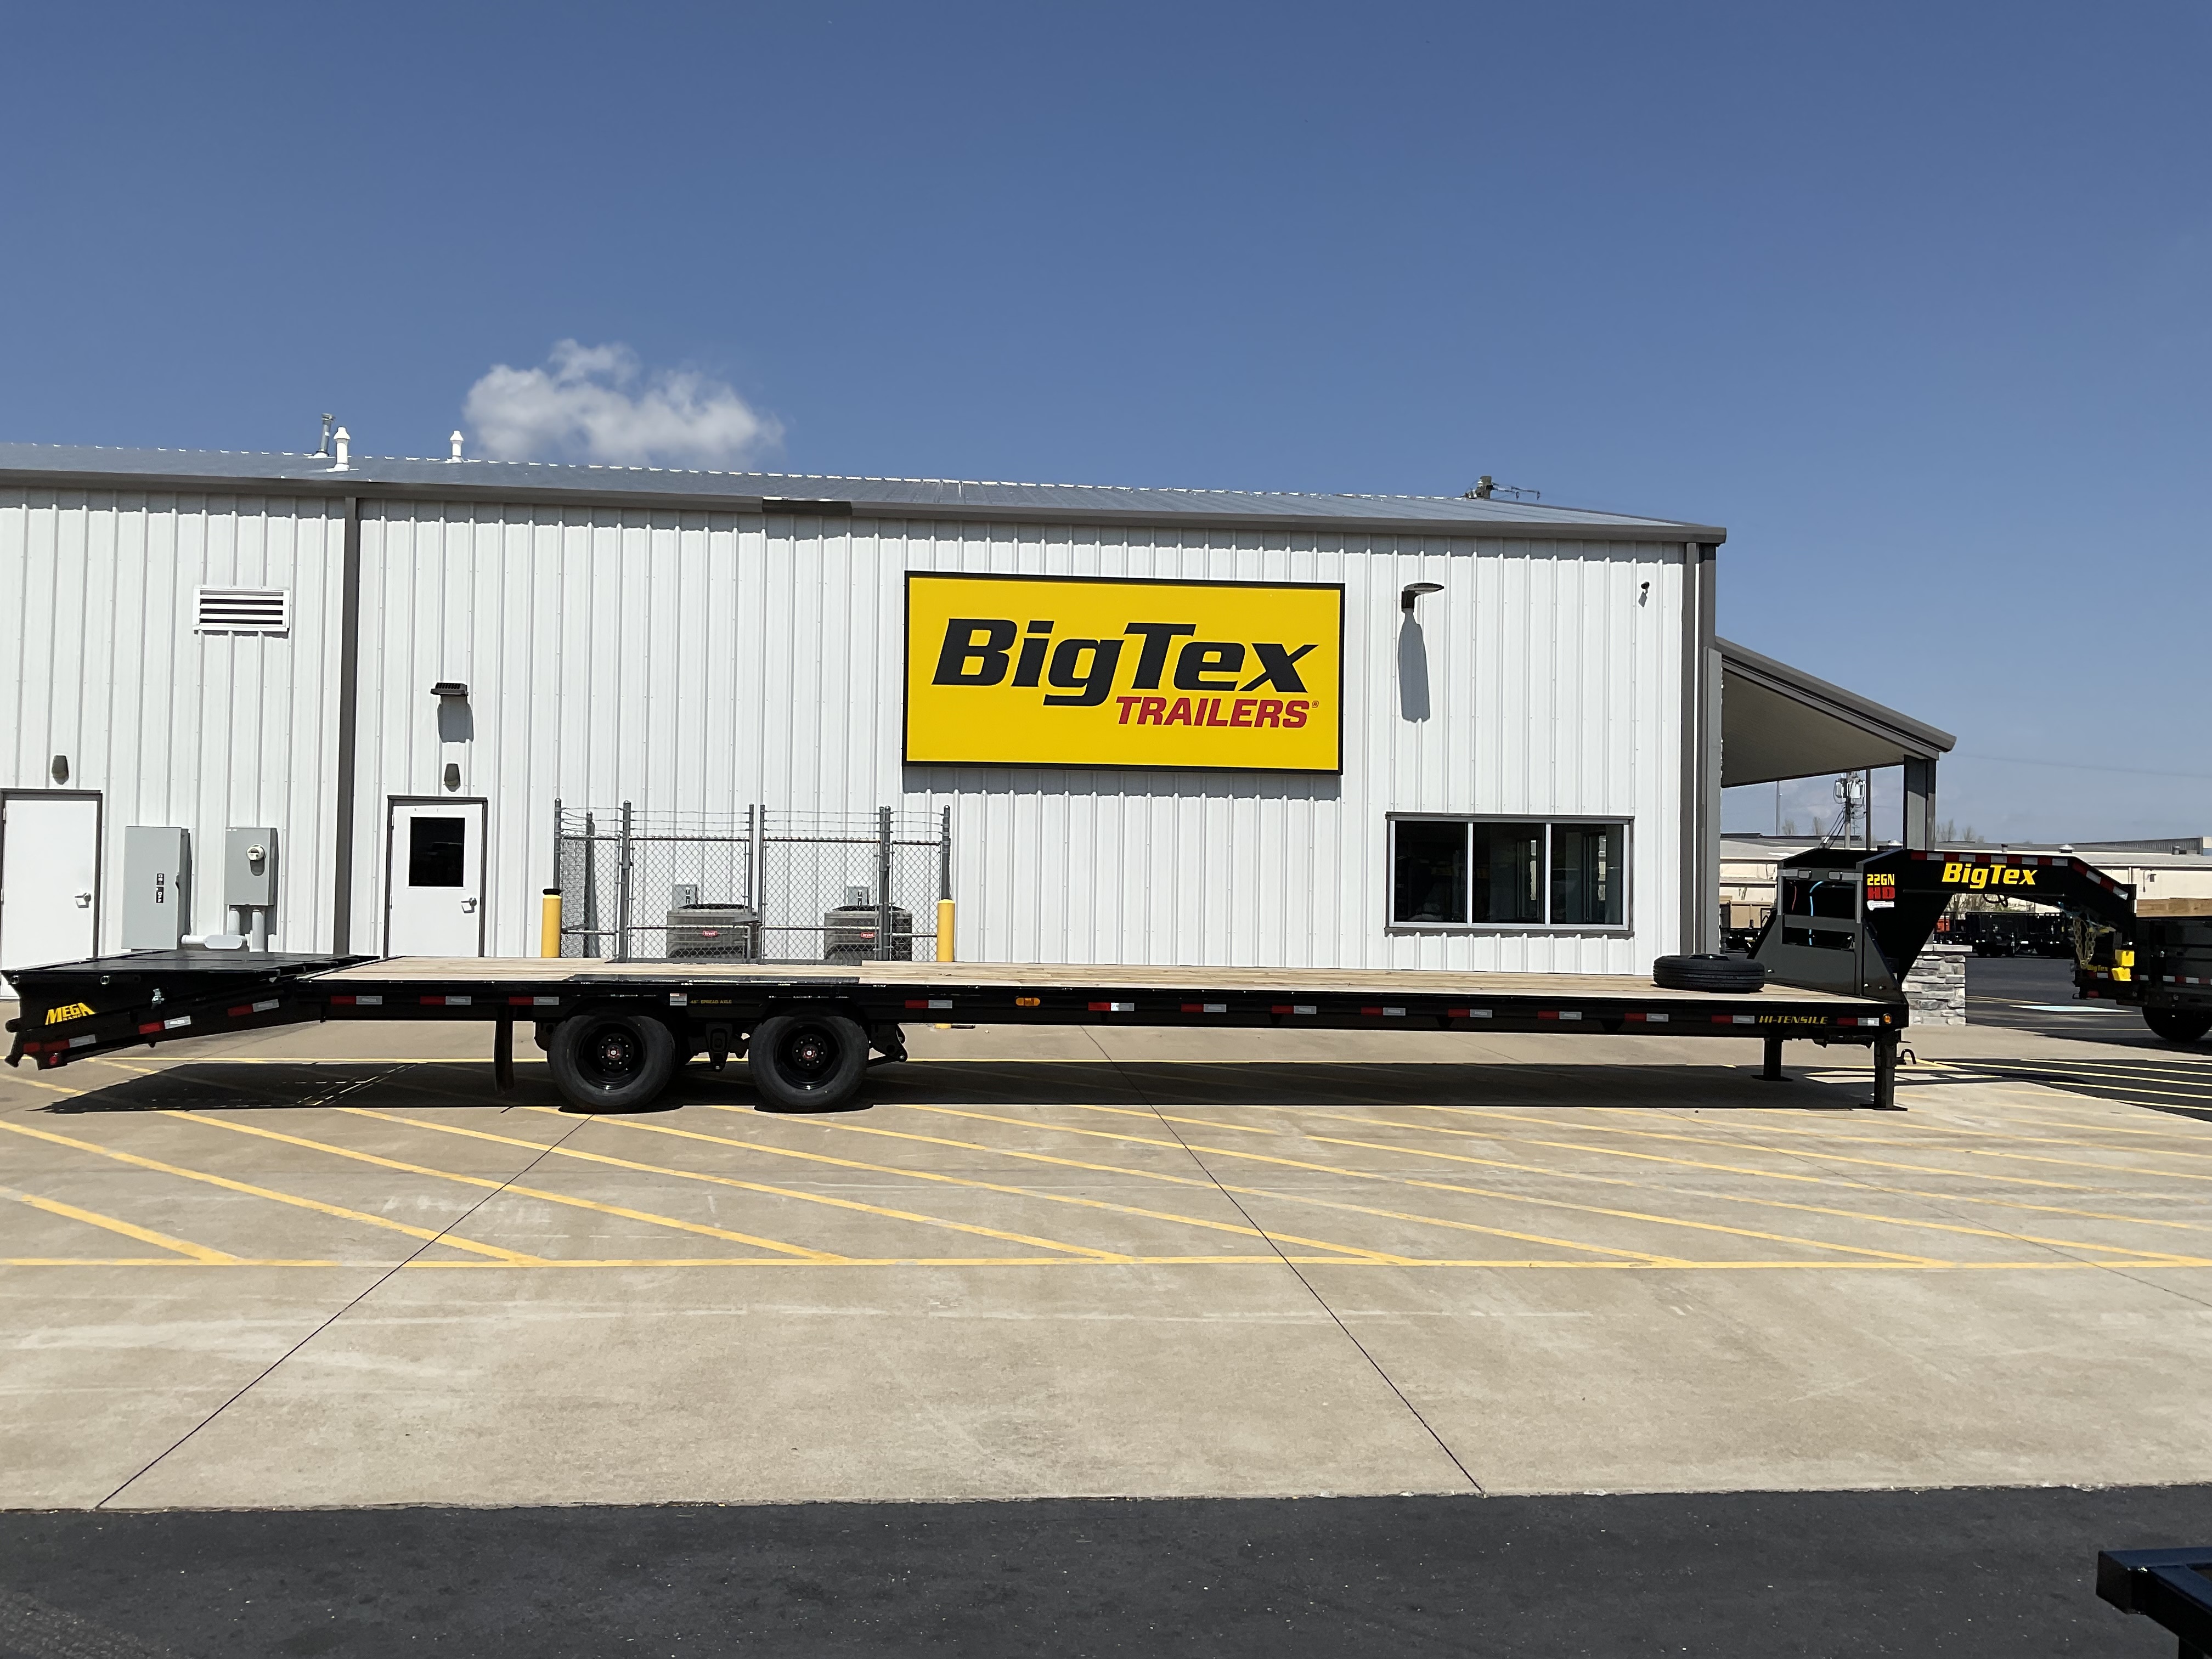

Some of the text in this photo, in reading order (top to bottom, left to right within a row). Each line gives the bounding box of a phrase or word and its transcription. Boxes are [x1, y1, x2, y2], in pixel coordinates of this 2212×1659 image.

[931, 618, 1319, 707] BigTex
[1867, 873, 1895, 885] 22GN
[1942, 862, 2038, 889] BigTex
[1867, 887, 1895, 899] HD
[45, 1002, 96, 1025] MEGA
[1759, 1015, 1828, 1024] HI-TENSILE
